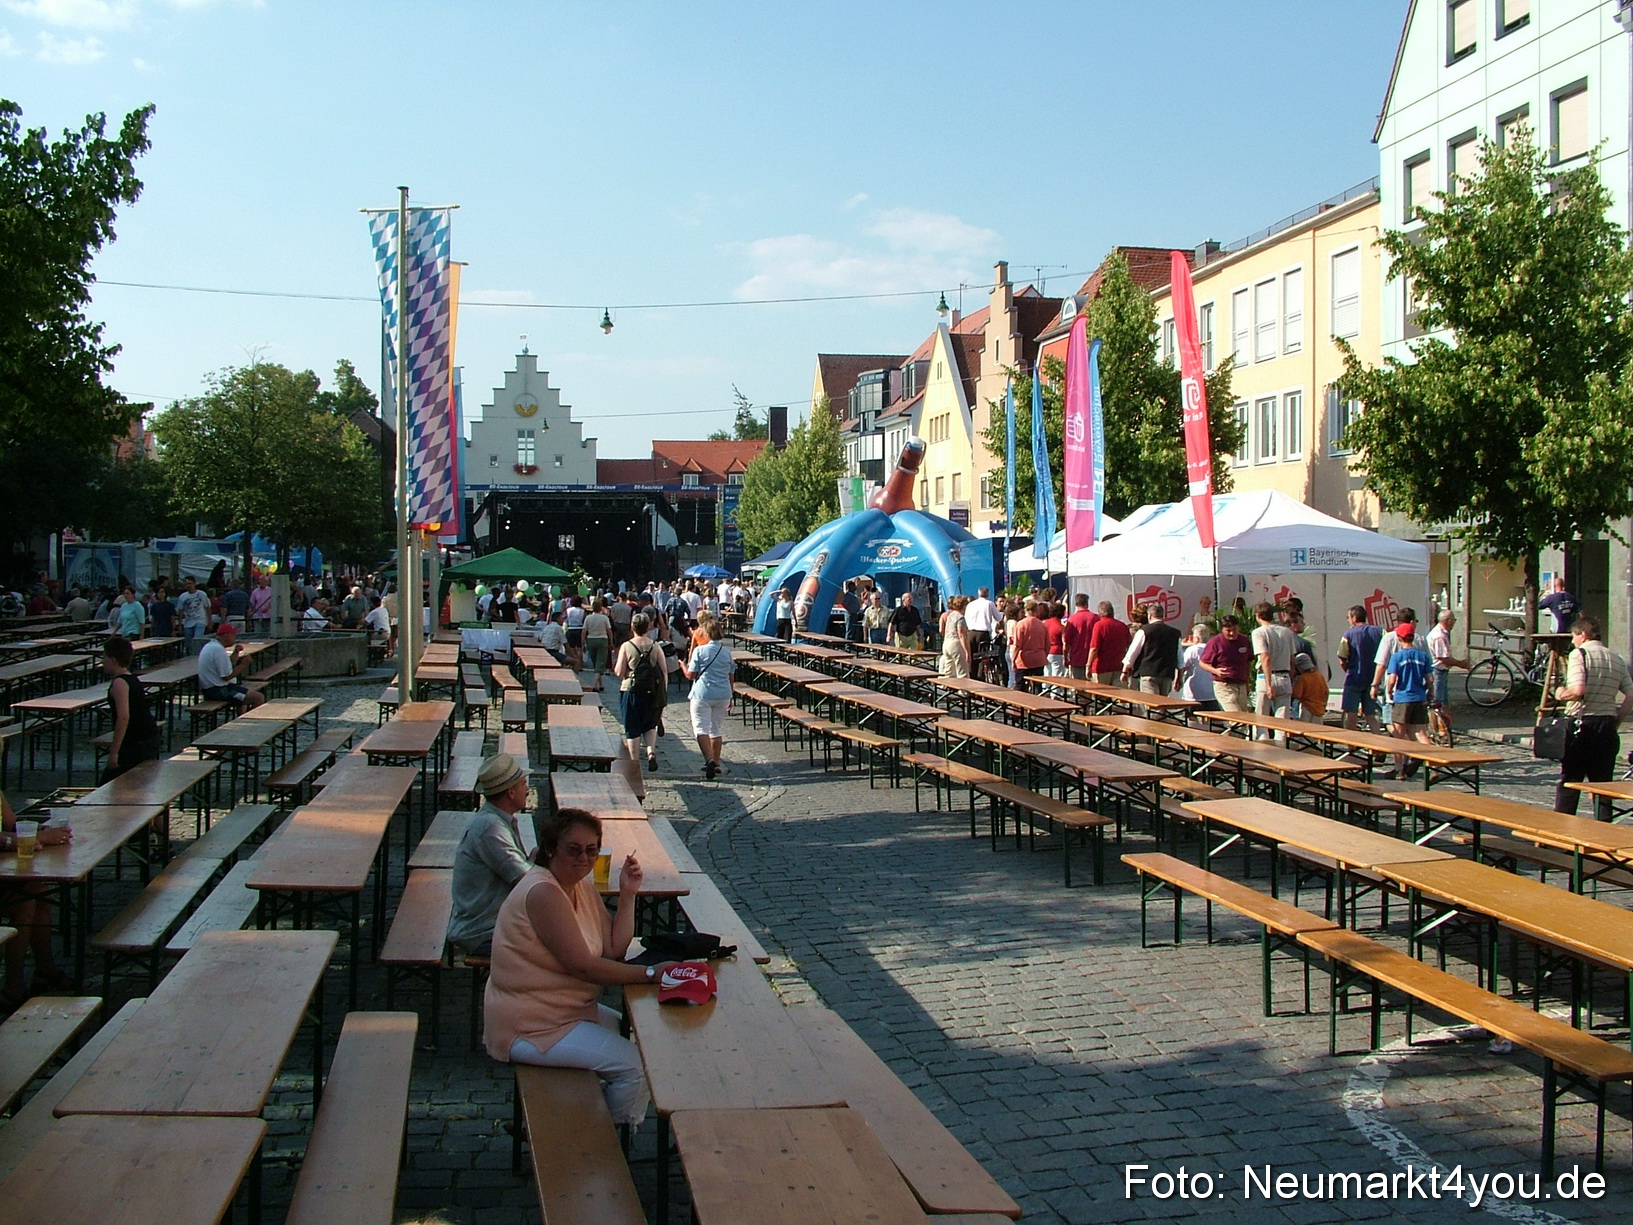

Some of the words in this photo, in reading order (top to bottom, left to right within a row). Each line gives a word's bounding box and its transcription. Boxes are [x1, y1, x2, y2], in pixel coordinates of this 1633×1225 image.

[1309, 547, 1360, 557] Bayerischer
[860, 556, 918, 565] Hacker-Pschorr
[1309, 557, 1349, 566] Rundfunk
